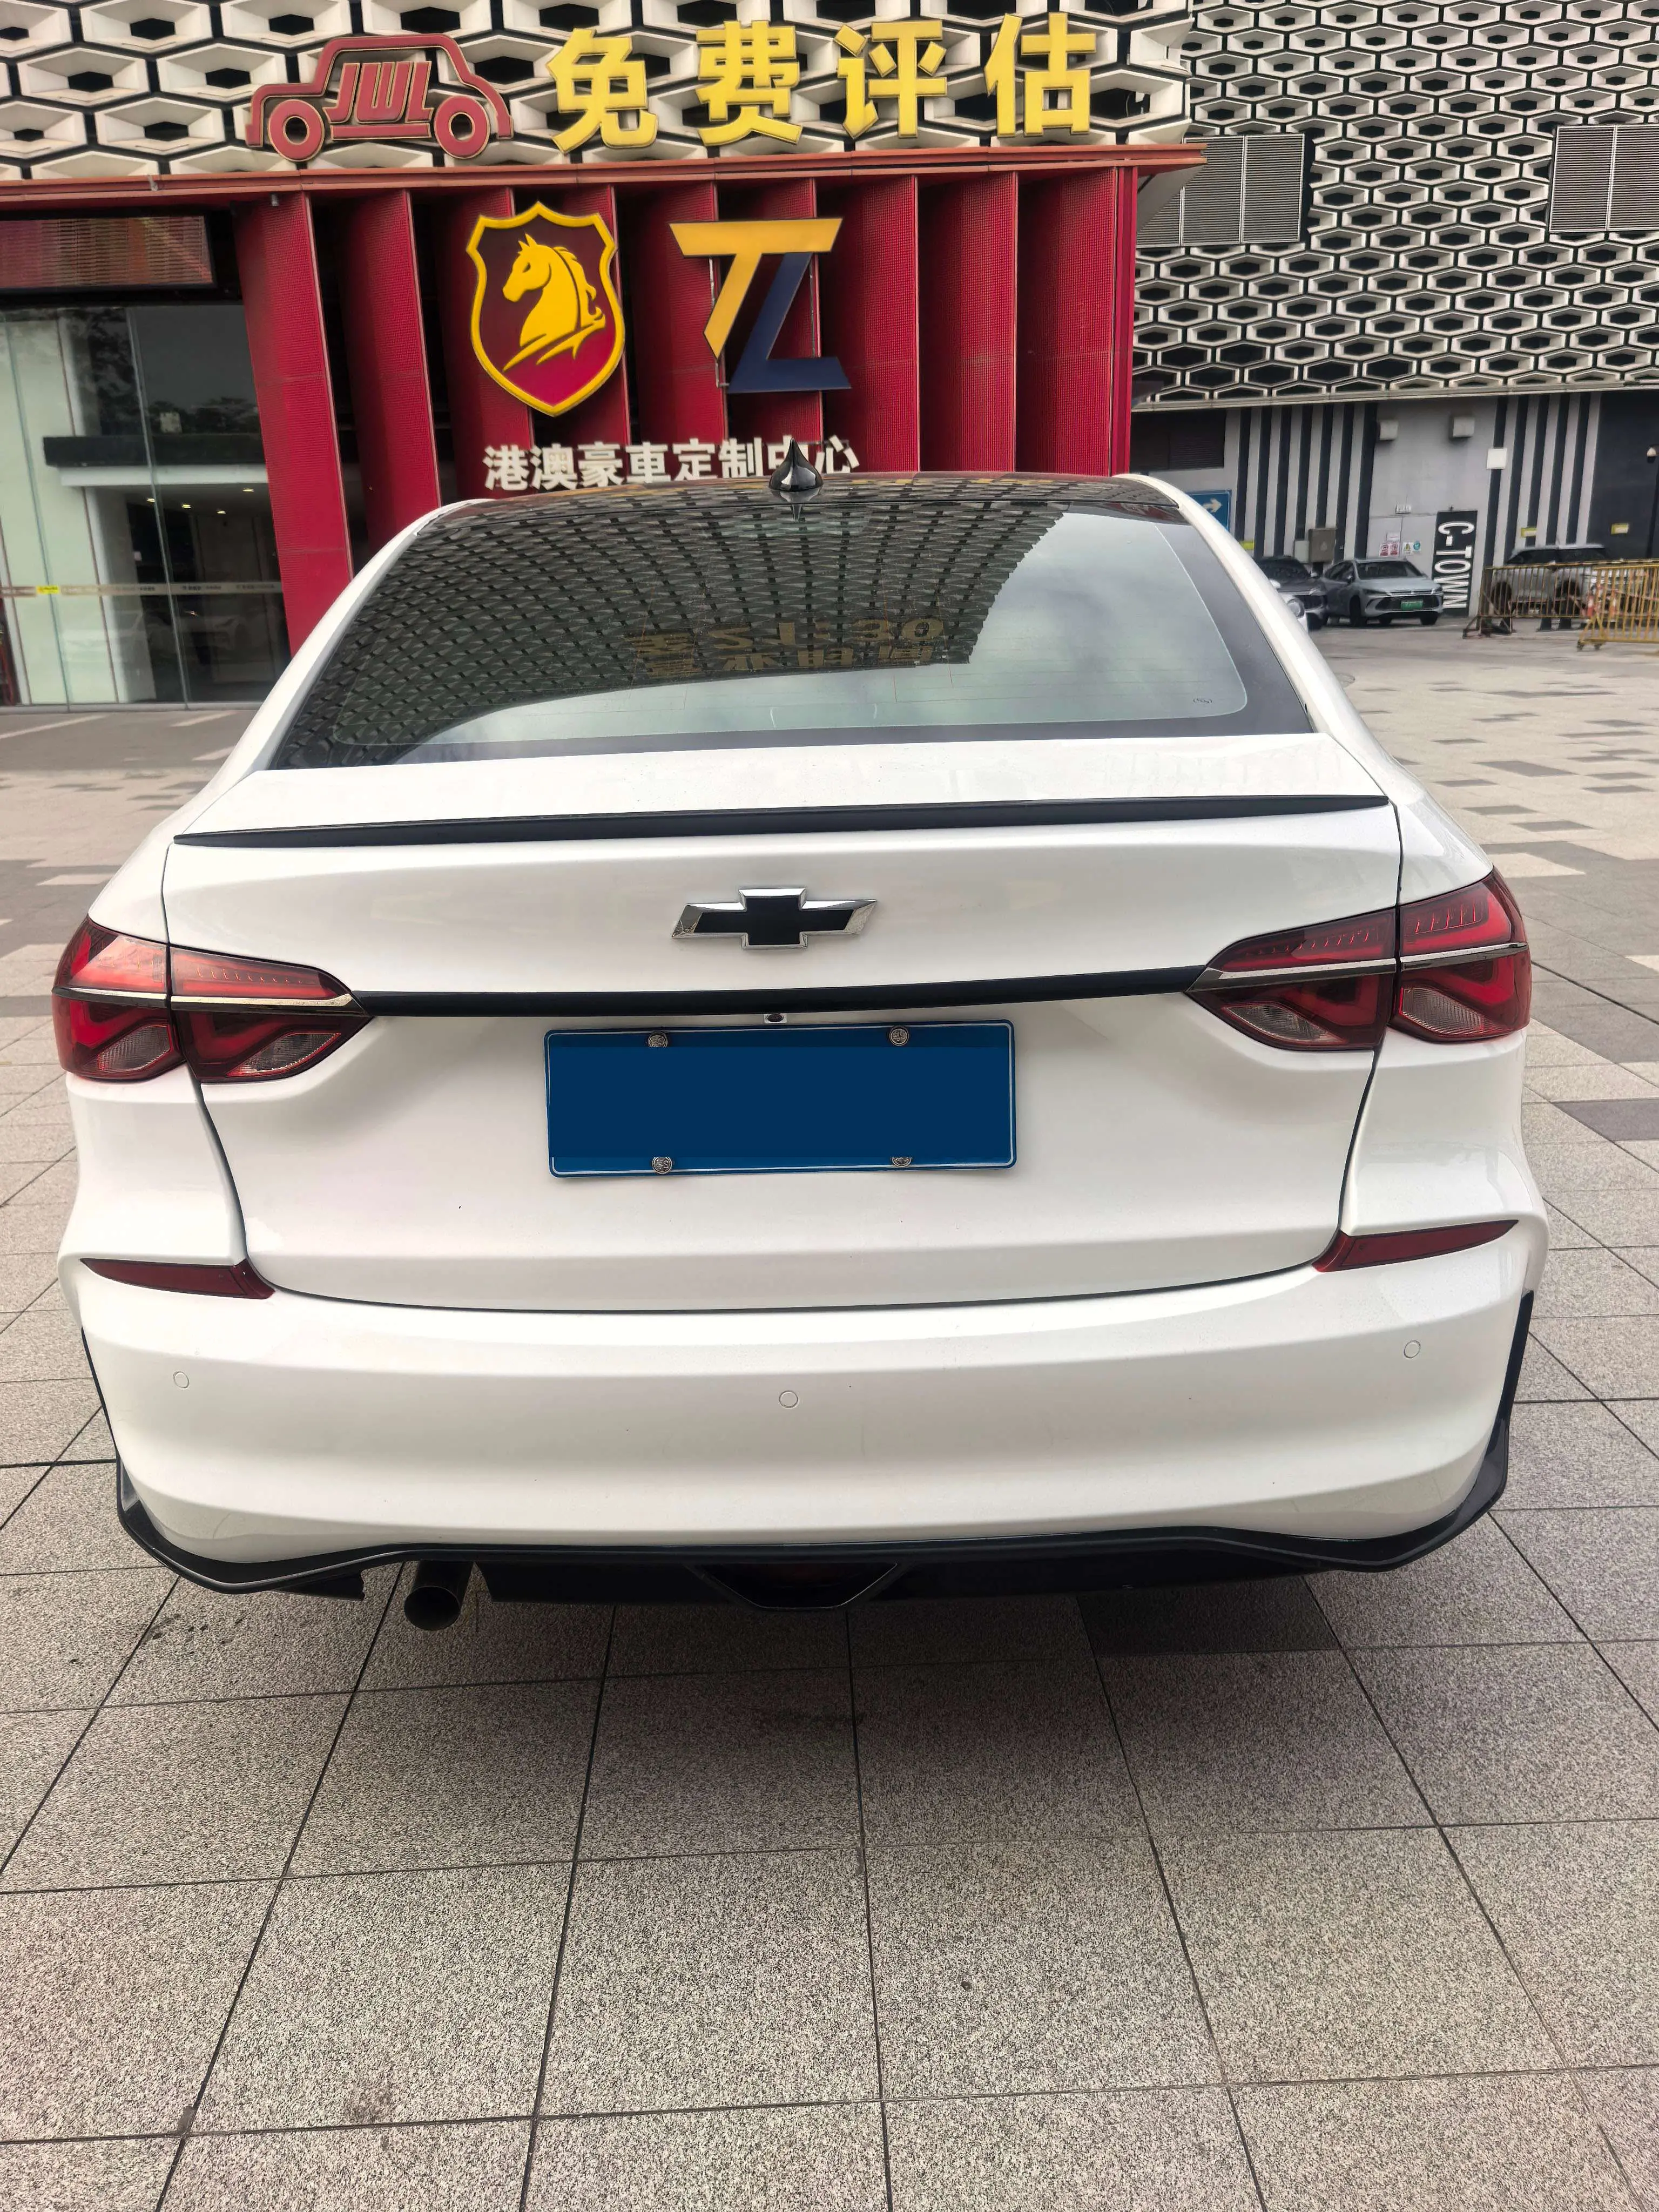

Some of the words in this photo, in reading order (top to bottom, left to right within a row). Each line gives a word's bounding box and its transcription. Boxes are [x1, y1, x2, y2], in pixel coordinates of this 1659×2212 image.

[546, 12, 1096, 154] 免费评估
[1432, 521, 1475, 609] C-TOWN
